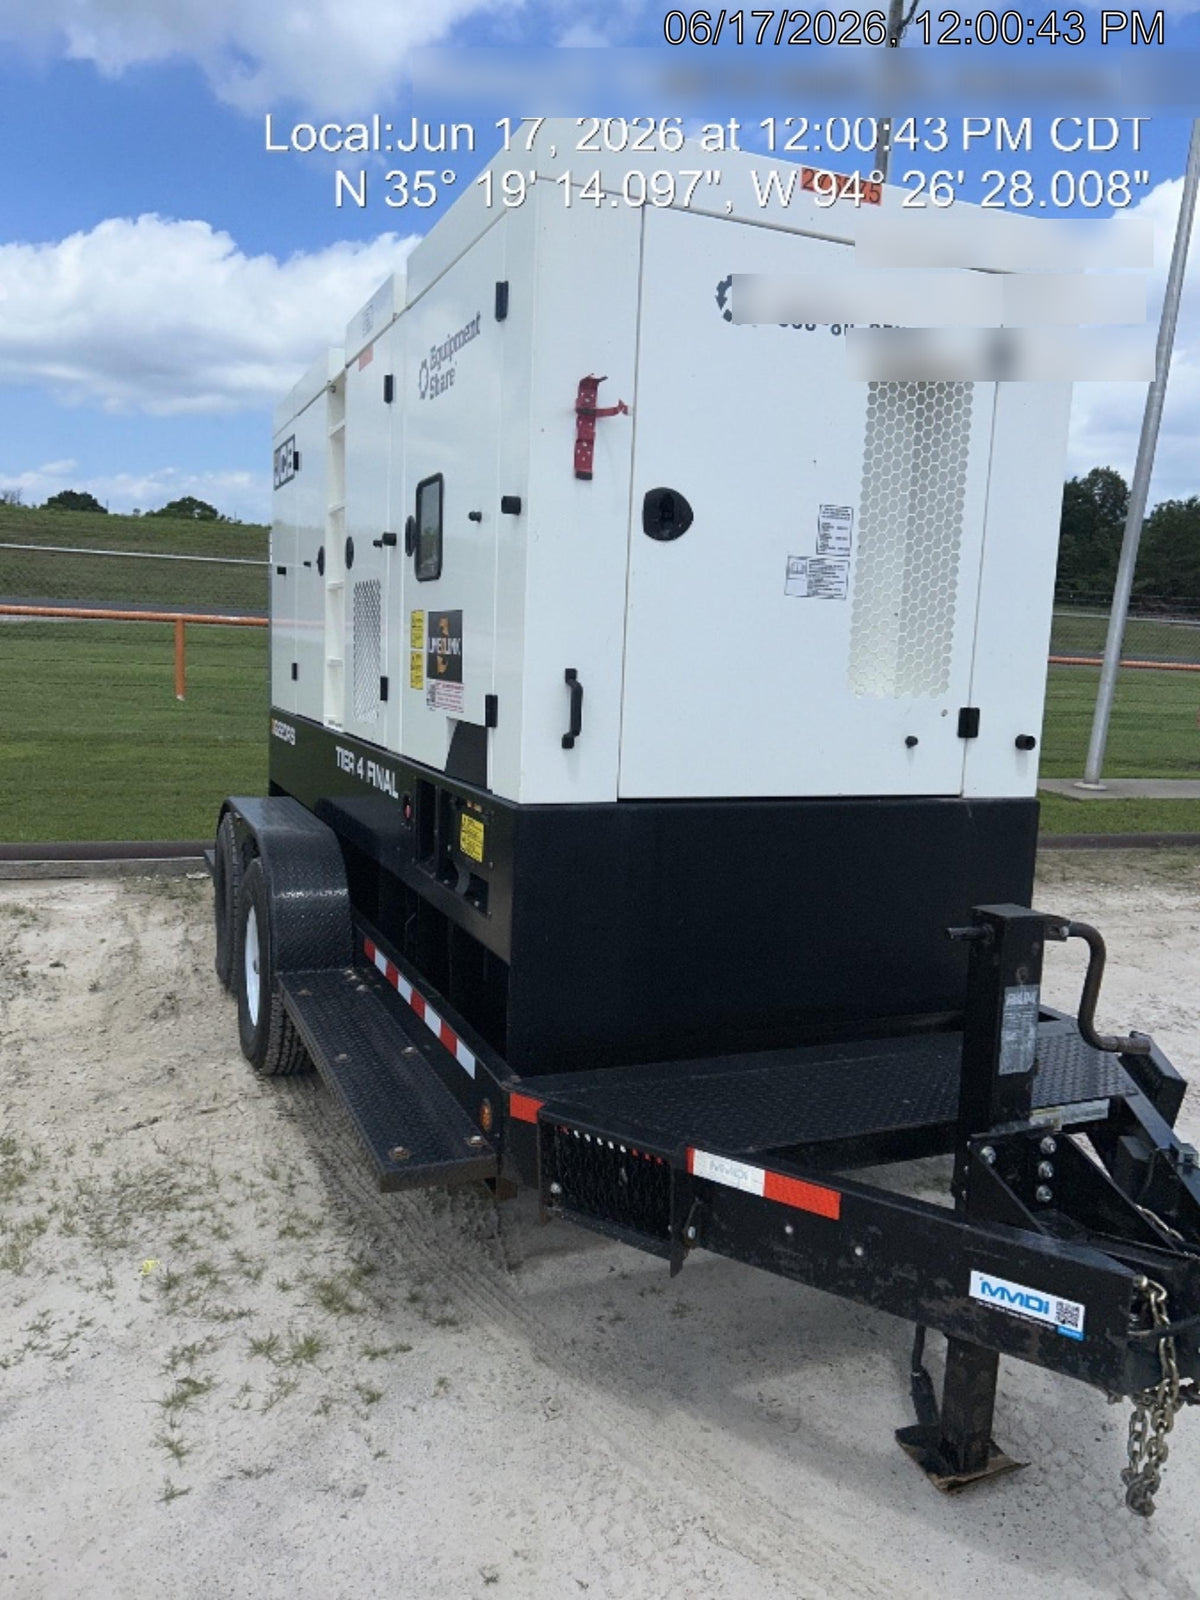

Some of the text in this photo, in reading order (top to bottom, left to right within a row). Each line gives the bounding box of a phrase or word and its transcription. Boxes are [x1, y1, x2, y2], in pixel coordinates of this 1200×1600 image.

[429, 311, 481, 371] Equipment
[429, 368, 456, 400] Share
[335, 744, 399, 800] TIER 4 FINAL
[981, 1281, 1049, 1315] MMDI
